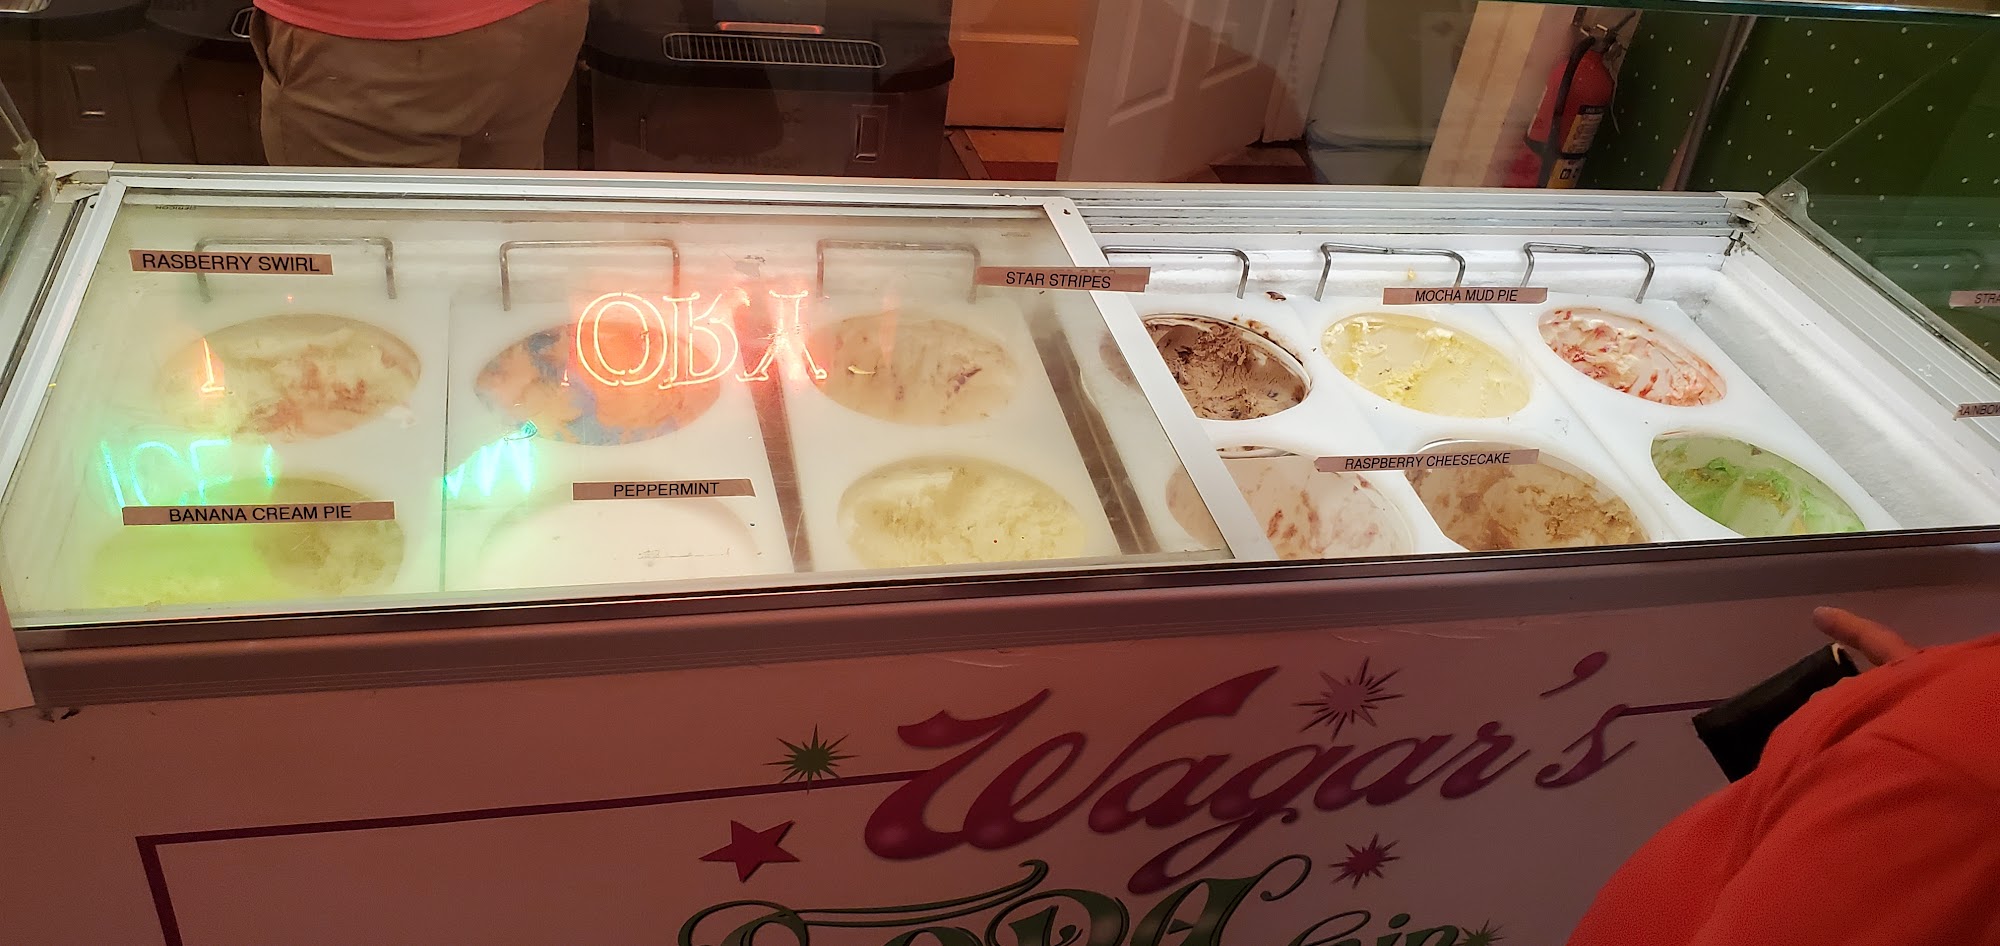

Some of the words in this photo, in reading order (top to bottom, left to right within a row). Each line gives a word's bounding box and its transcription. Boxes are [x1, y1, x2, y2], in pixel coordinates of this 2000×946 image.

[142, 253, 253, 271] RASBERRY
[258, 256, 320, 272] SWIRL
[1005, 271, 1045, 286] STAR
[1049, 273, 1112, 290] STRIPES
[1415, 289, 1461, 302] MOCHA
[1465, 289, 1494, 302] MUD
[1497, 289, 1518, 302] PIE
[1345, 456, 1424, 470] RASPBERRY
[1426, 453, 1511, 467] CHEESECAKE
[613, 482, 720, 497] PEPPERMINT
[169, 507, 248, 523] BANANA
[251, 506, 318, 521] CREAM
[323, 504, 352, 519] PIE
[864, 651, 1636, 894] Wagar's
